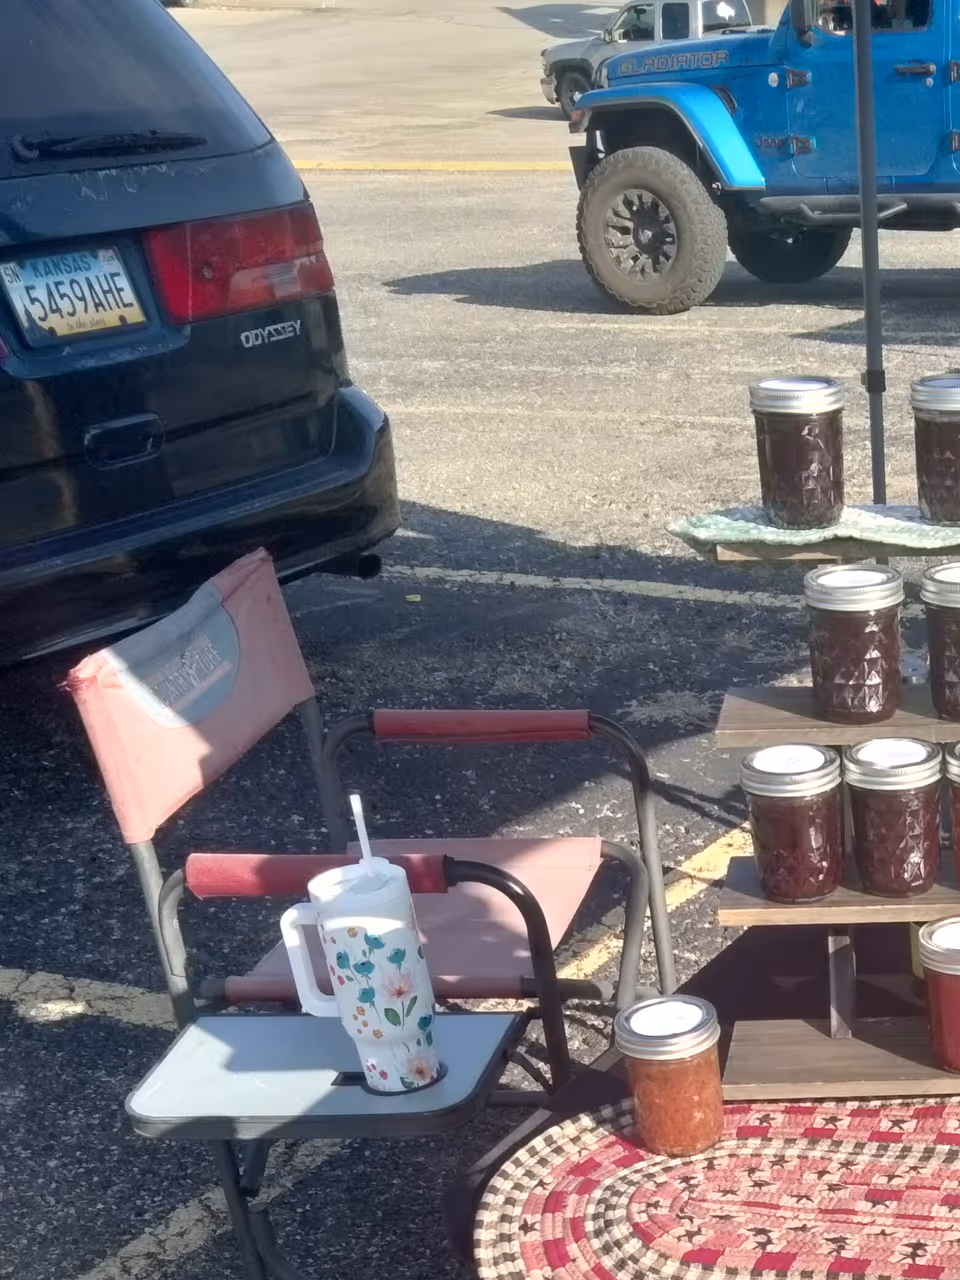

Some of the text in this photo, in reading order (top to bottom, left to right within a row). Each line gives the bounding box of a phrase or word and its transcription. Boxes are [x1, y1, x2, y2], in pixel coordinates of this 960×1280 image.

[619, 51, 728, 75] GLADIATOR
[29, 254, 92, 279] KANSAS
[24, 271, 134, 322] 5459AHE
[240, 319, 301, 348] ODYSSEY
